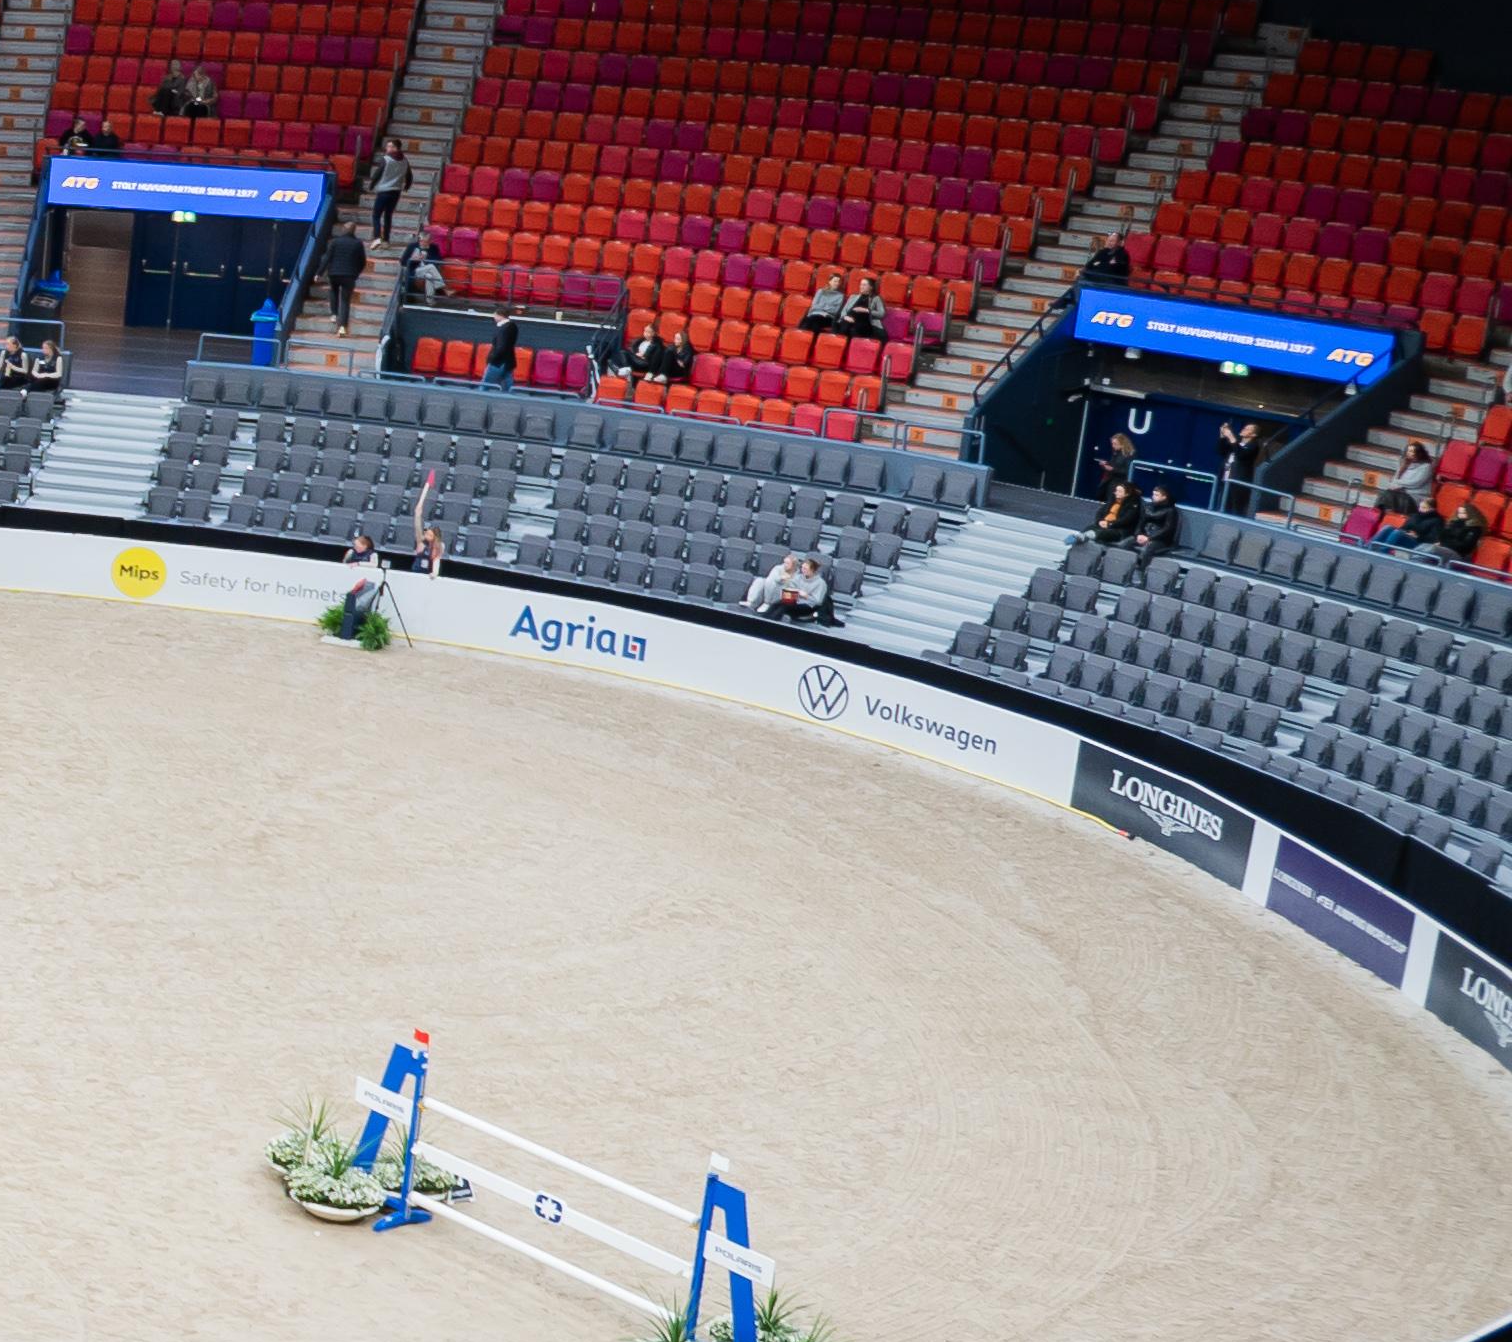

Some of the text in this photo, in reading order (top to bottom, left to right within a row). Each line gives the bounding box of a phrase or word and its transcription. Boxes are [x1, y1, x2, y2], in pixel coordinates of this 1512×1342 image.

[61, 175, 100, 191] ATG
[111, 180, 136, 191] STOLT
[207, 187, 236, 198] SEDAN
[269, 188, 309, 204] ATG
[1091, 310, 1135, 329] ATG
[1147, 320, 1175, 333] STOLT
[1254, 335, 1289, 351] SEDAN
[1326, 347, 1374, 367] ATG
[1128, 409, 1153, 435] U
[119, 561, 160, 585] Mips
[179, 570, 238, 593] Safety
[243, 575, 270, 594] for
[510, 604, 618, 658] Agria
[865, 695, 998, 755] Volkswagen
[1109, 769, 1224, 842] LONGINES
[1459, 966, 1512, 1031] LONG
[365, 1090, 404, 1113] POLARIS
[715, 1246, 763, 1274] POLARIS
